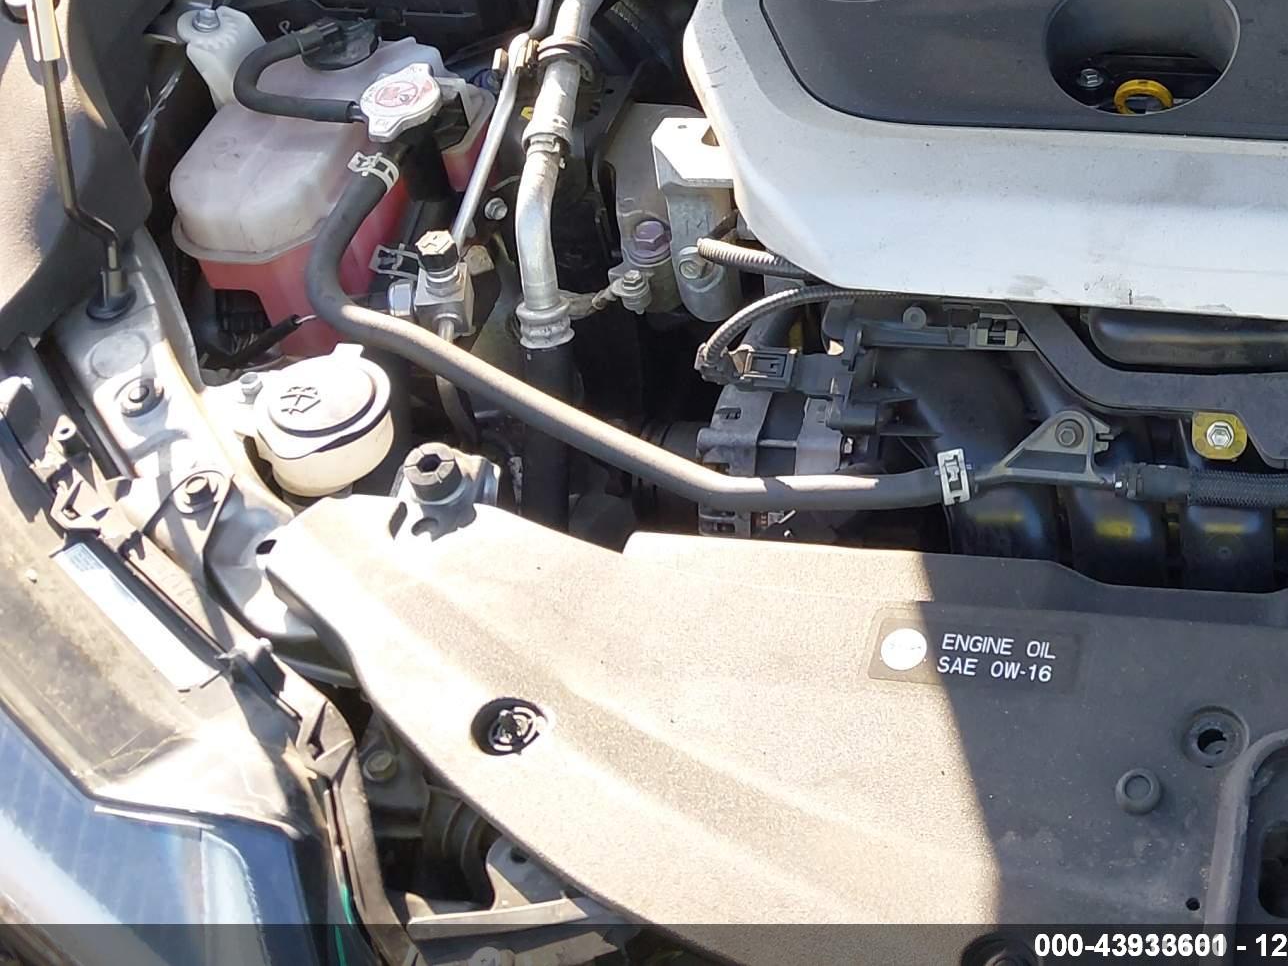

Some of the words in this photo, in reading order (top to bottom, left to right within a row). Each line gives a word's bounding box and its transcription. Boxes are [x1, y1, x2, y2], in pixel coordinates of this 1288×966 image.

[942, 633, 1014, 655] ENGINE
[1027, 641, 1056, 660] OIL
[937, 656, 978, 676] SAE
[990, 661, 1052, 682] 0W-16
